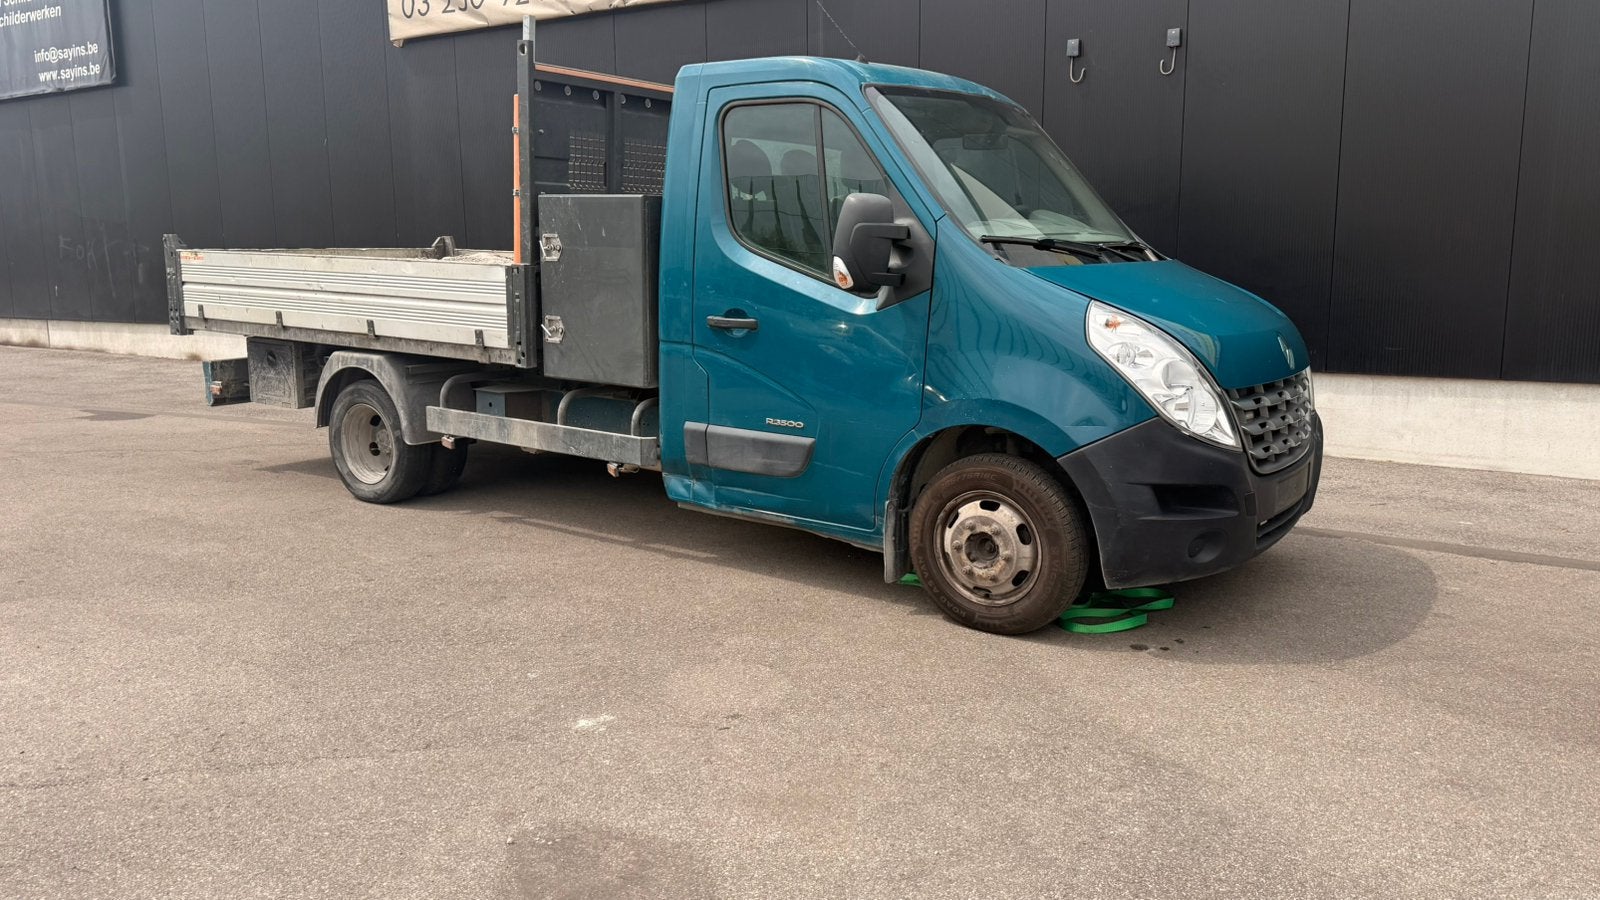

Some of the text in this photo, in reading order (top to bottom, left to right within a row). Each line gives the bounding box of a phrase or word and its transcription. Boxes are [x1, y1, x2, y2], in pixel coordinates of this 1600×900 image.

[34, 41, 98, 63] info@sayins.be
[39, 62, 101, 82] www.sayins.be
[765, 418, 804, 428] R3500
